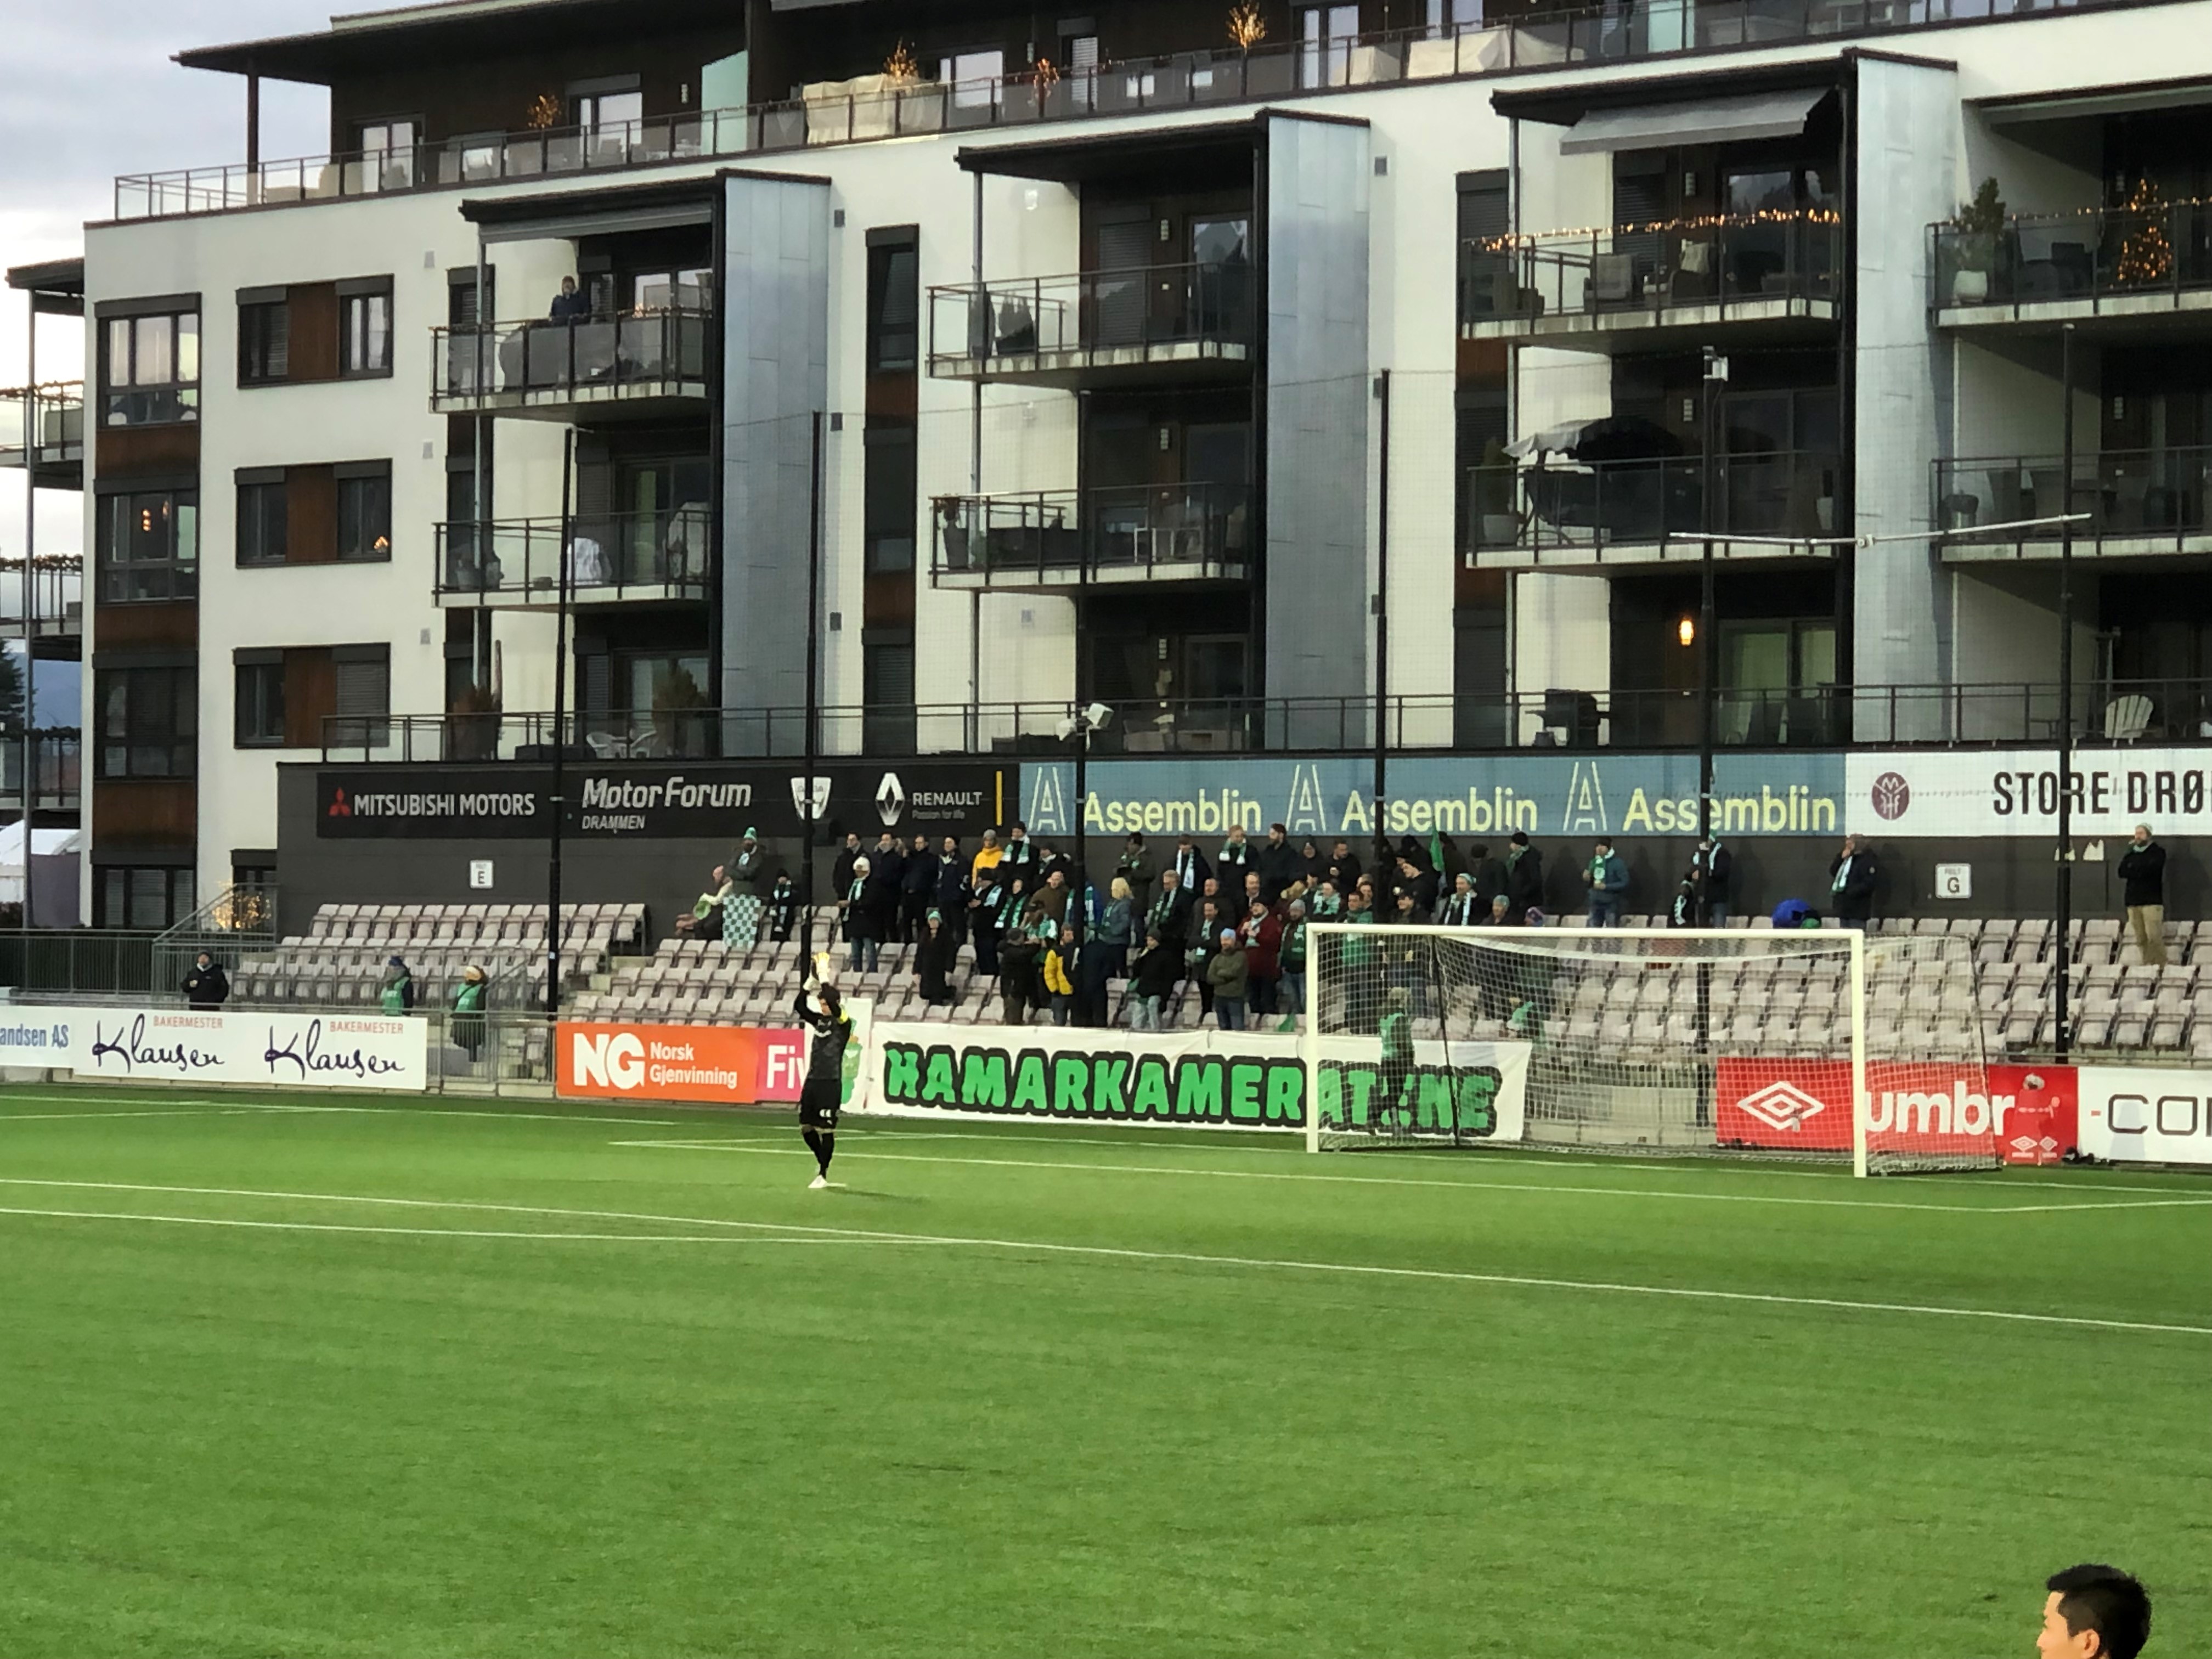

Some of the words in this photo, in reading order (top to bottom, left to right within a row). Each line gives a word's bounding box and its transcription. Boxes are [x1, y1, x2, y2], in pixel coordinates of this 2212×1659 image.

[582, 776, 752, 808] MotorForum
[912, 791, 983, 806] RENAULT
[1994, 771, 2109, 815] STORE
[2128, 770, 2212, 814] DRØ
[354, 793, 455, 816] MITSUBISHI
[459, 793, 535, 816] MOTORS
[1084, 788, 1261, 832] Assemblin
[1341, 786, 1537, 832] Assemblin
[1623, 785, 1836, 832] Assemblin
[582, 815, 646, 830] DRAMMEN
[478, 871, 485, 884] E
[1948, 877, 1960, 893] G
[153, 1015, 223, 1029] BAKERMESTER
[329, 1021, 403, 1034] BAKERMESTER
[52, 1024, 69, 1048] AS
[92, 1013, 225, 1074] Klausen
[264, 1019, 405, 1080] Klausen
[573, 1032, 645, 1090] NG
[650, 1041, 694, 1061] Norsk
[650, 1064, 737, 1089] Gjenvinning
